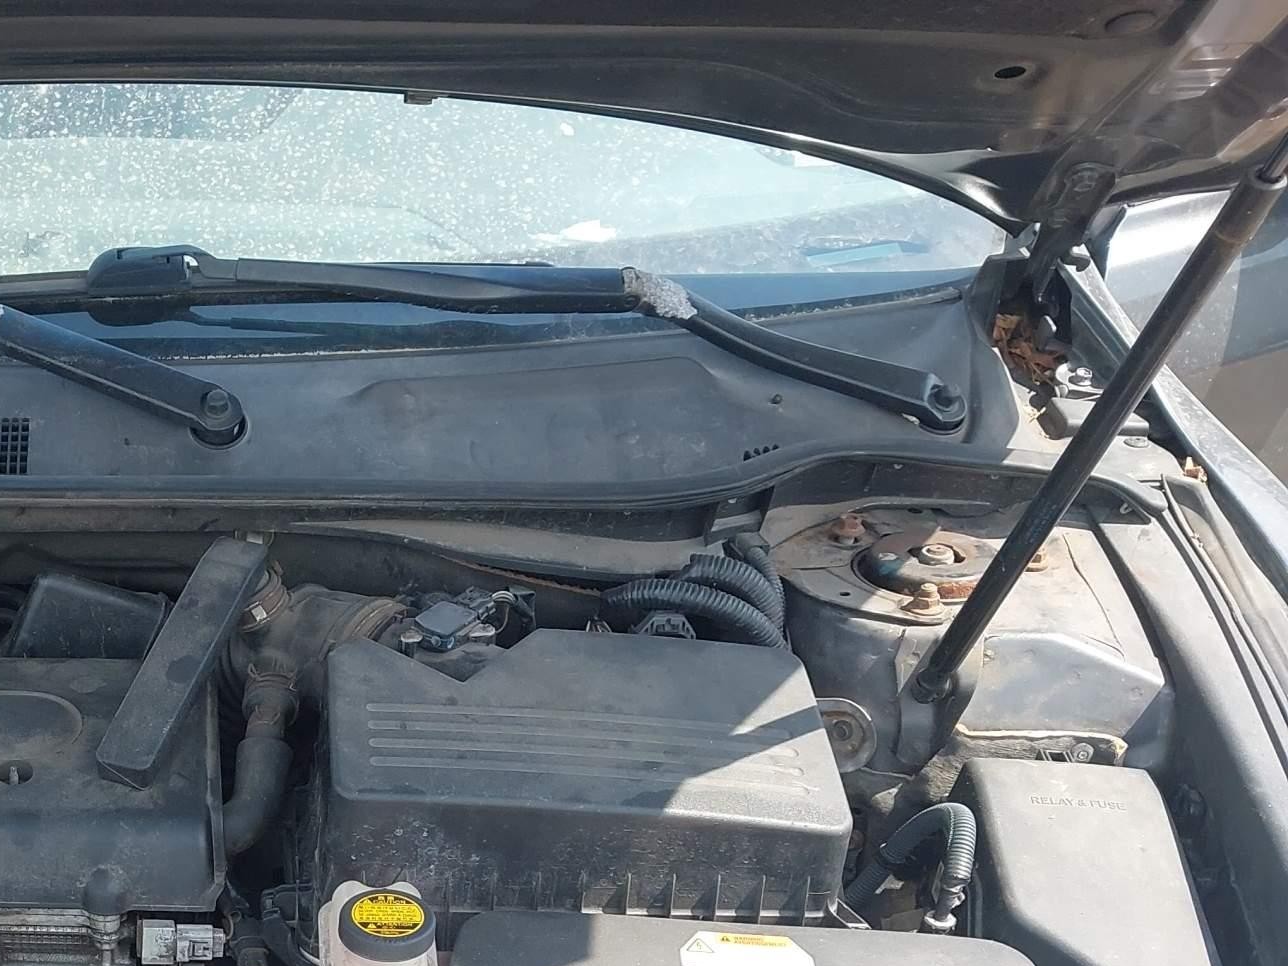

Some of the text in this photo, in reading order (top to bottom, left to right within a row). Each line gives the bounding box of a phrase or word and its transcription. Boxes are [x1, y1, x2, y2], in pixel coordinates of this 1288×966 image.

[1030, 795, 1128, 811] RELAY & FUSE
